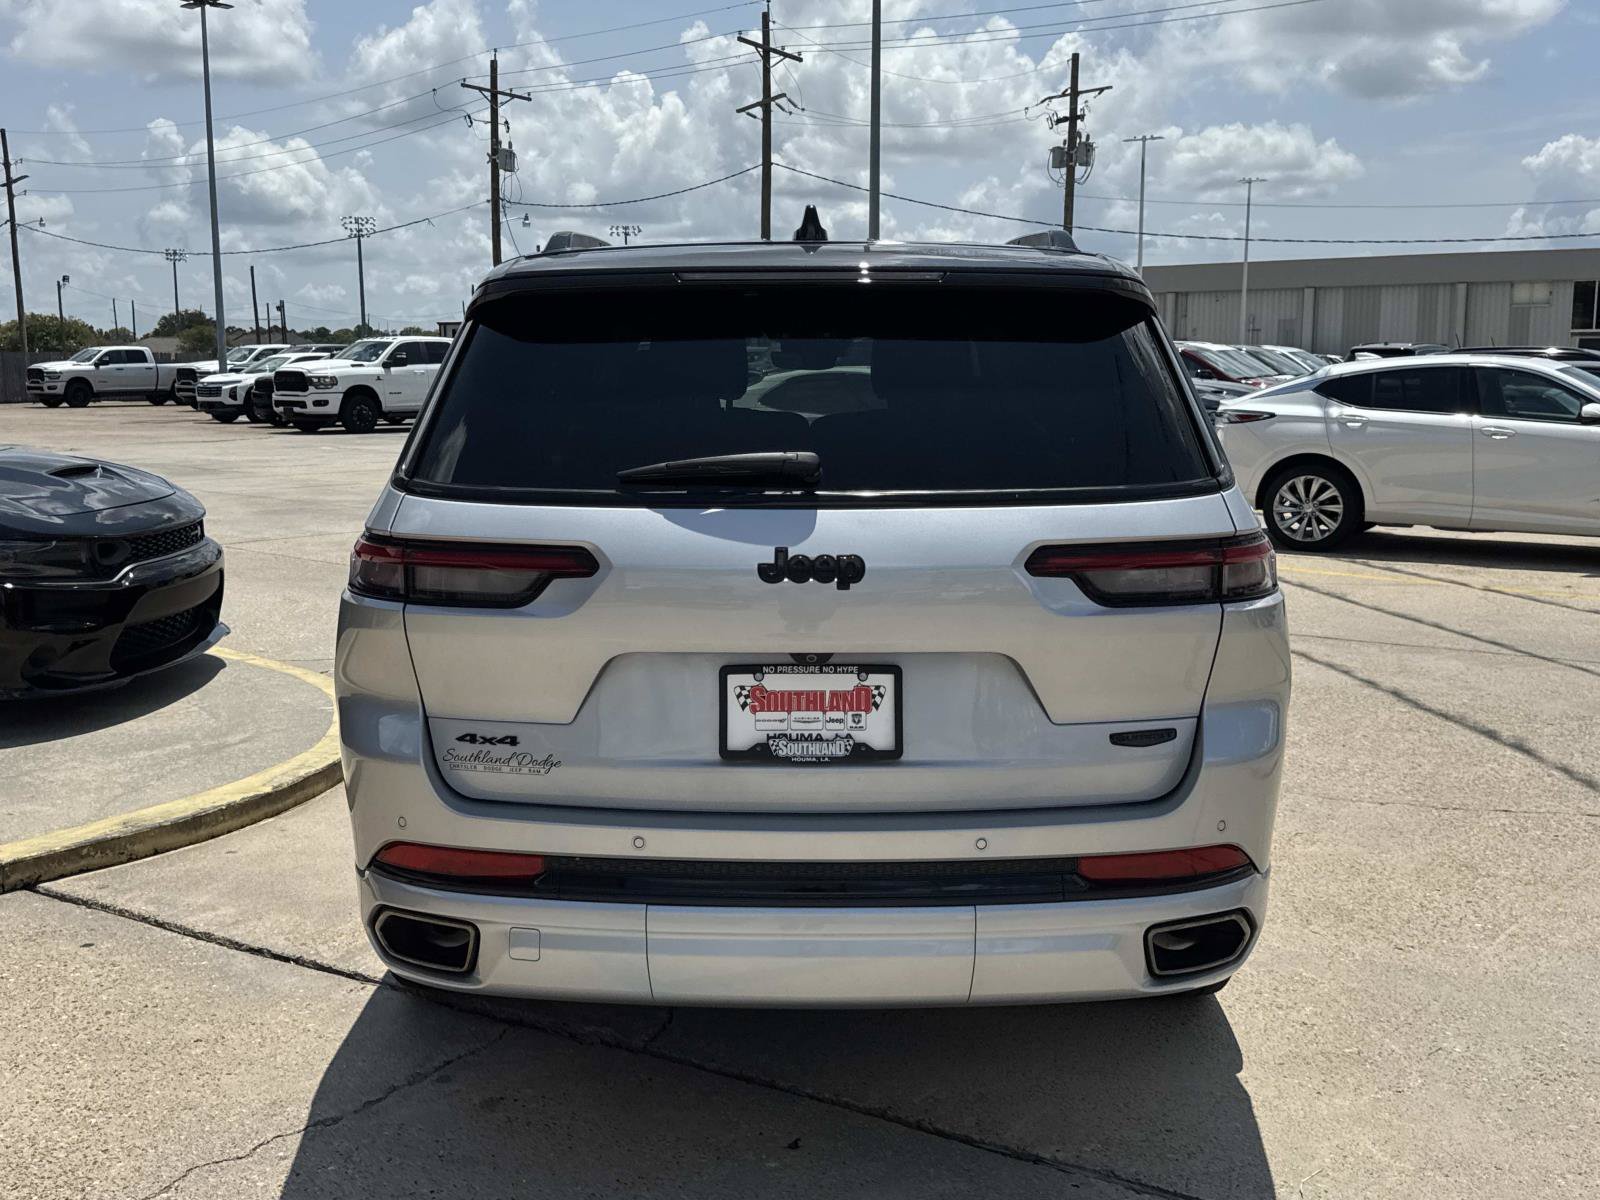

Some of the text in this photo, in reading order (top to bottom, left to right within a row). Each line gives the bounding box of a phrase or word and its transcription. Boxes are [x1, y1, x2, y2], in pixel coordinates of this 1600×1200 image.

[757, 546, 866, 590] Jeep
[762, 666, 859, 674] NO PRESSURE NO HYPE
[750, 685, 873, 713] SOUTHLAND
[455, 733, 520, 746] 4x4
[778, 740, 845, 756] SOUTHLAND
[443, 748, 562, 774] Southland Dodge
